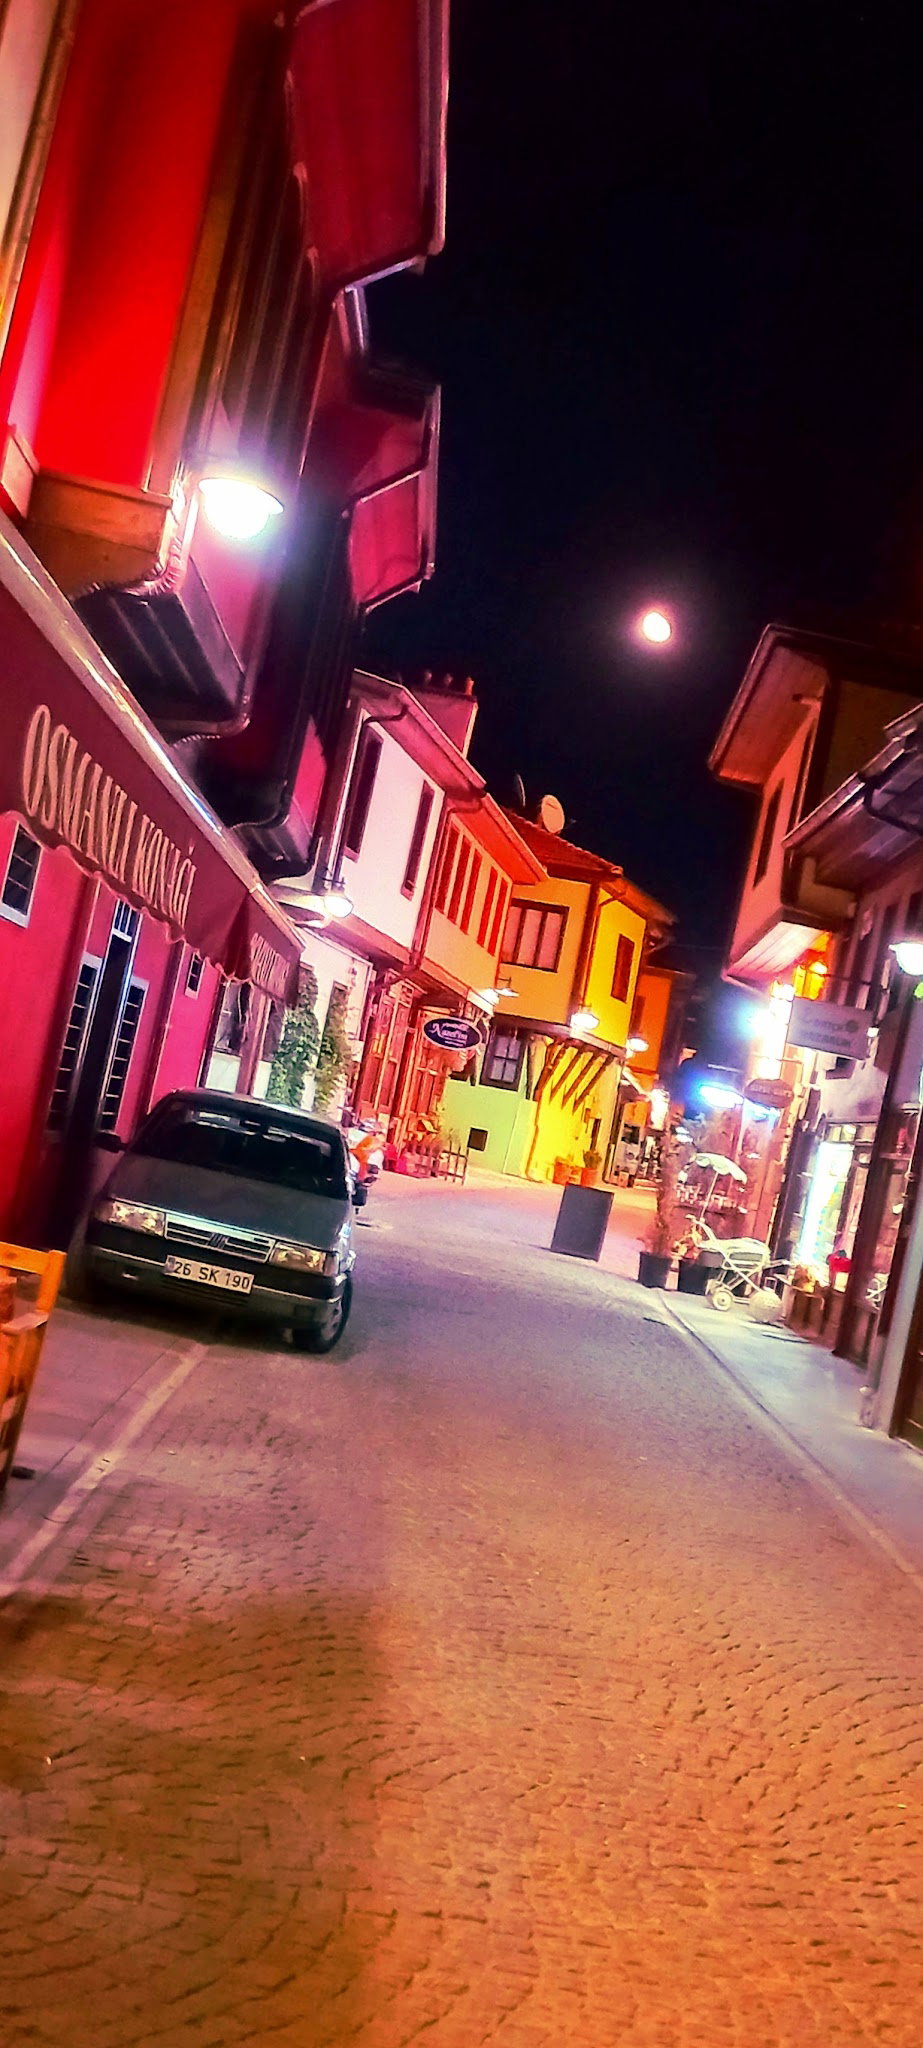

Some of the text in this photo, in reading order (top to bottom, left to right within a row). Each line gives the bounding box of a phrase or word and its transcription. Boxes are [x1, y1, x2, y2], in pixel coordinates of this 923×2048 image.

[23, 704, 197, 931] OSMANLI KONAĞI
[173, 1261, 250, 1290] 26 SK 190
